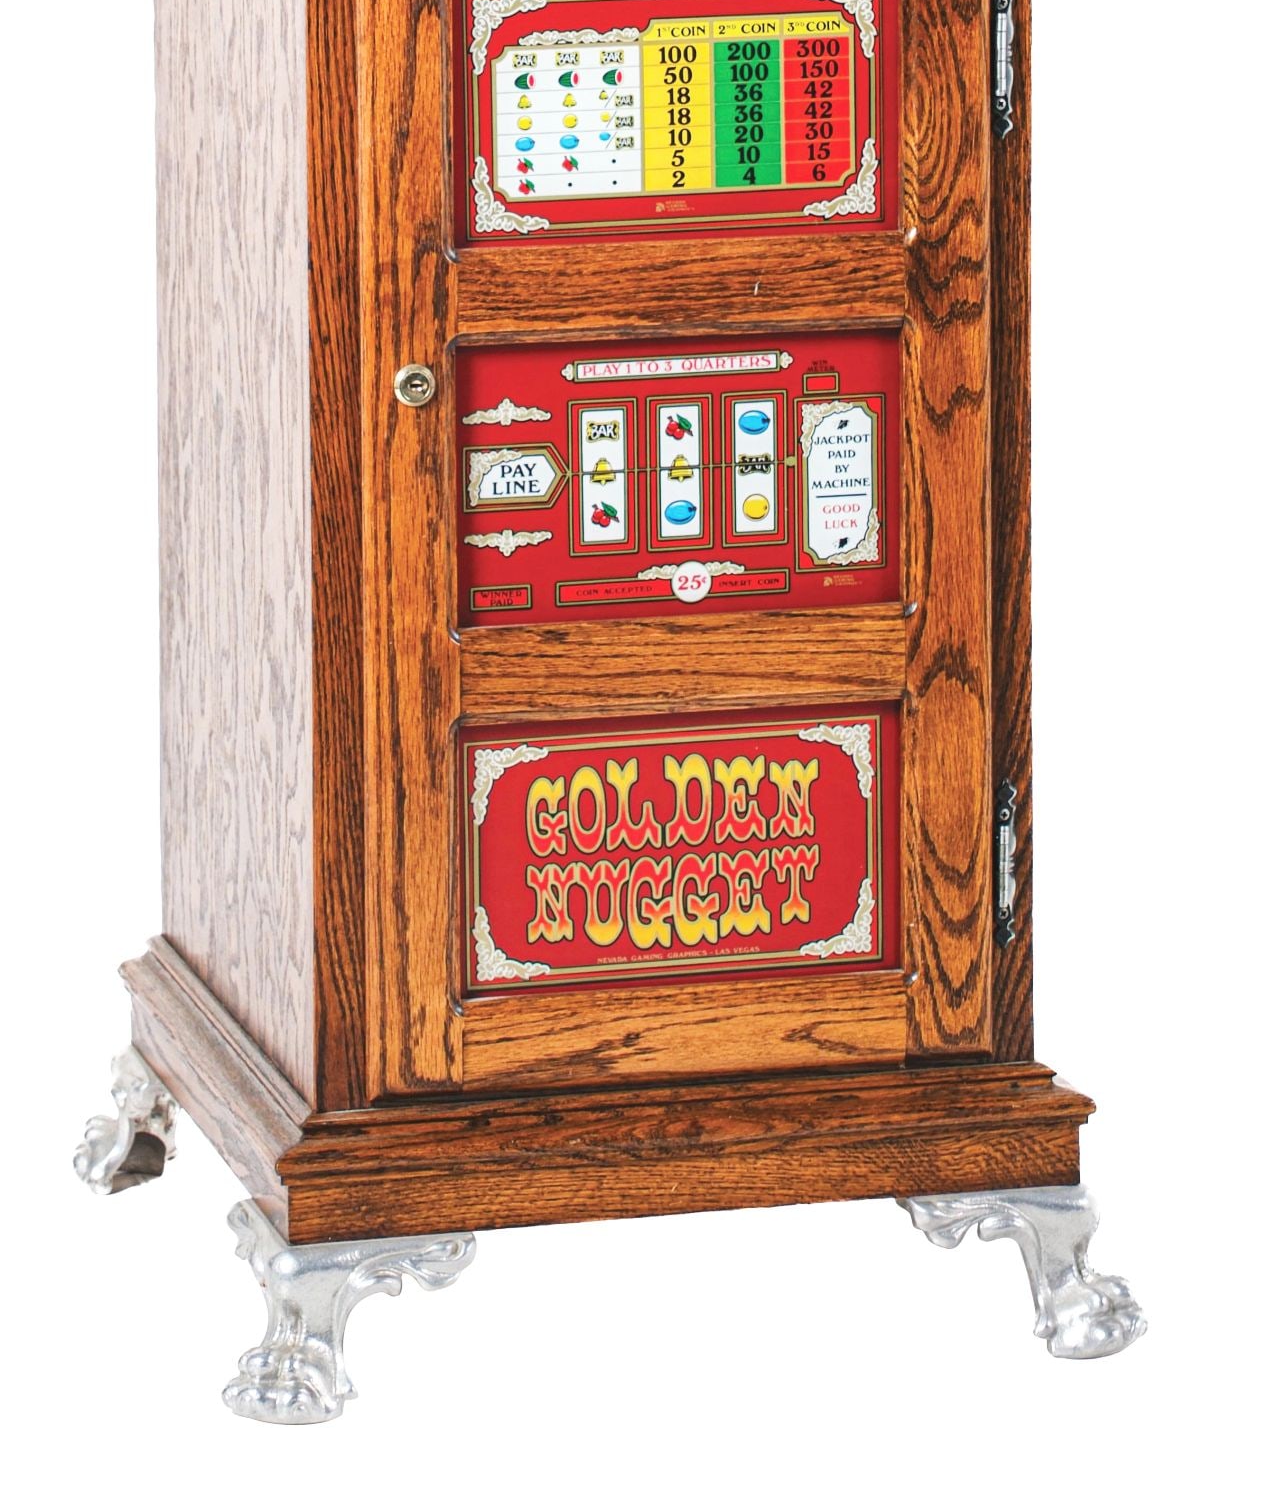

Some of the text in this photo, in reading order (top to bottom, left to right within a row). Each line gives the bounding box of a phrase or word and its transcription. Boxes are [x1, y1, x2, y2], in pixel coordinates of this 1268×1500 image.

[671, 25, 706, 37] COIN
[741, 22, 776, 34] COIN
[806, 20, 841, 32] COIN
[658, 45, 697, 64] 100
[727, 41, 771, 61] 200
[796, 38, 841, 58] 300
[663, 66, 693, 84] 50
[730, 62, 769, 82] 100
[799, 59, 839, 79] 150
[667, 86, 691, 105] 18
[734, 83, 763, 102] 36
[803, 80, 833, 98] 42
[667, 107, 691, 126] 18
[734, 104, 763, 123] 36
[804, 101, 833, 119] 42
[668, 128, 692, 146] 10
[734, 124, 764, 143] 20
[805, 121, 834, 140] 30
[671, 149, 685, 167] 5
[737, 145, 760, 164] 10
[807, 142, 831, 161] 15
[672, 170, 685, 188] 2
[742, 167, 756, 185] 4
[812, 163, 826, 182] 6
[582, 355, 772, 377] PLAY 1 TO 3 QUARTERS
[814, 434, 871, 445] JACKPOT
[828, 449, 856, 459] PAID
[500, 462, 536, 478] PAY
[834, 464, 850, 473] BY
[492, 479, 541, 496] LINE
[812, 477, 871, 489] MACHINE
[823, 504, 861, 514] GOOD
[825, 518, 858, 529] LUCK
[480, 588, 523, 599] WINNER
[525, 752, 820, 857] GOLDEN
[526, 843, 820, 950] NUGGET
[715, 948, 730, 956] LAS
[733, 946, 761, 954] VEGAS
